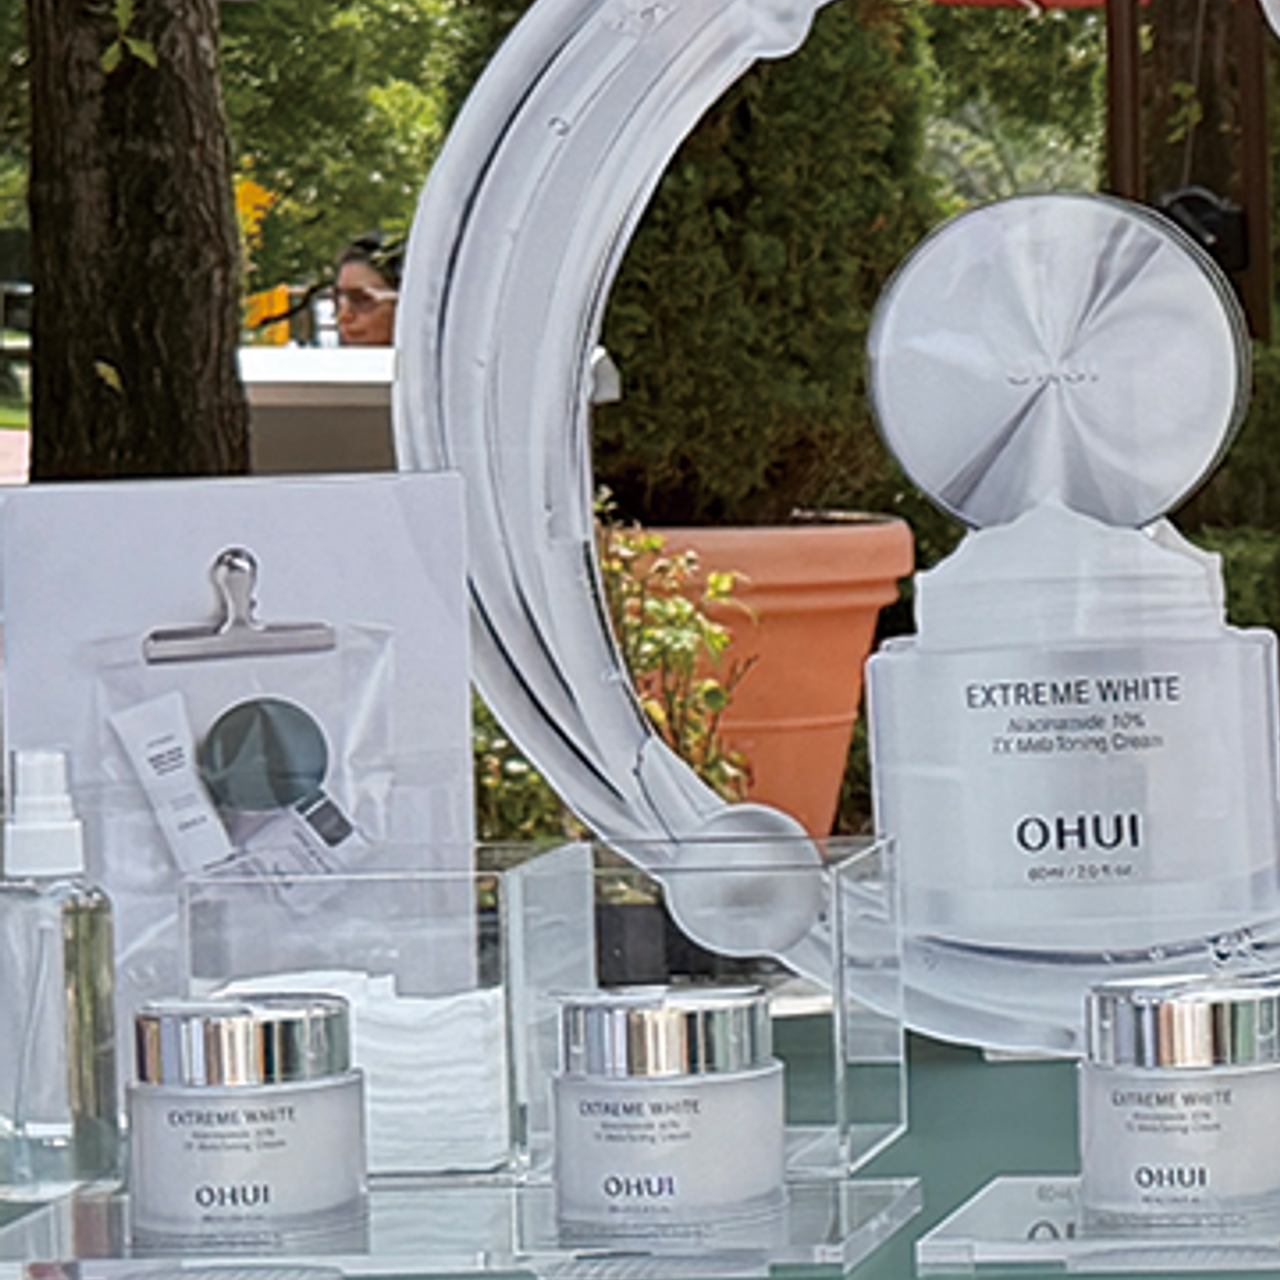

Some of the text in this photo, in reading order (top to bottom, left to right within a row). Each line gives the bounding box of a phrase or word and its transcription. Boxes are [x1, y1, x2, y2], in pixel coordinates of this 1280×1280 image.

[966, 675, 1180, 709] EXTREME WHITE
[1016, 812, 1141, 853] OHUI
[604, 1176, 675, 1198] OHUI
[1134, 1167, 1207, 1189] OHUI
[195, 1184, 271, 1208] OHUI
